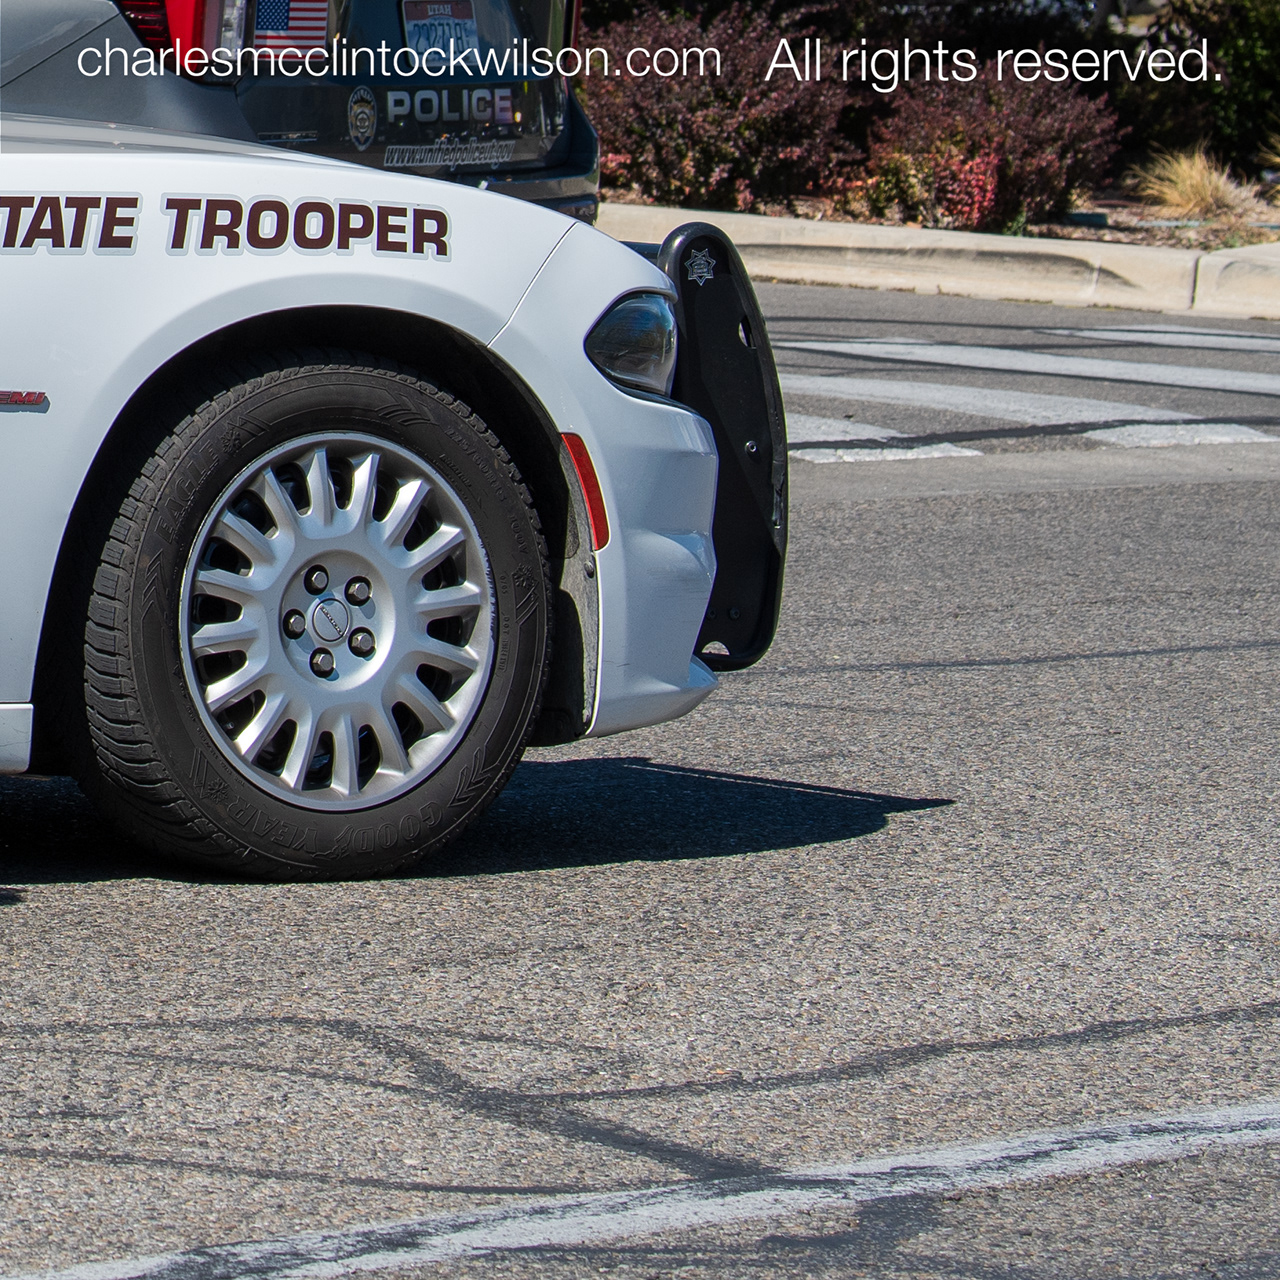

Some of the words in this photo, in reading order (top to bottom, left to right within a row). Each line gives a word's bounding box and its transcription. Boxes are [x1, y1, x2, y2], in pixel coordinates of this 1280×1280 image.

[427, 4, 452, 16] UTAH
[387, 88, 513, 124] POLICE
[384, 138, 515, 170] www.unifiedpoliceut.gov
[165, 198, 448, 257] TROOPER
[153, 439, 220, 544] EAGLE
